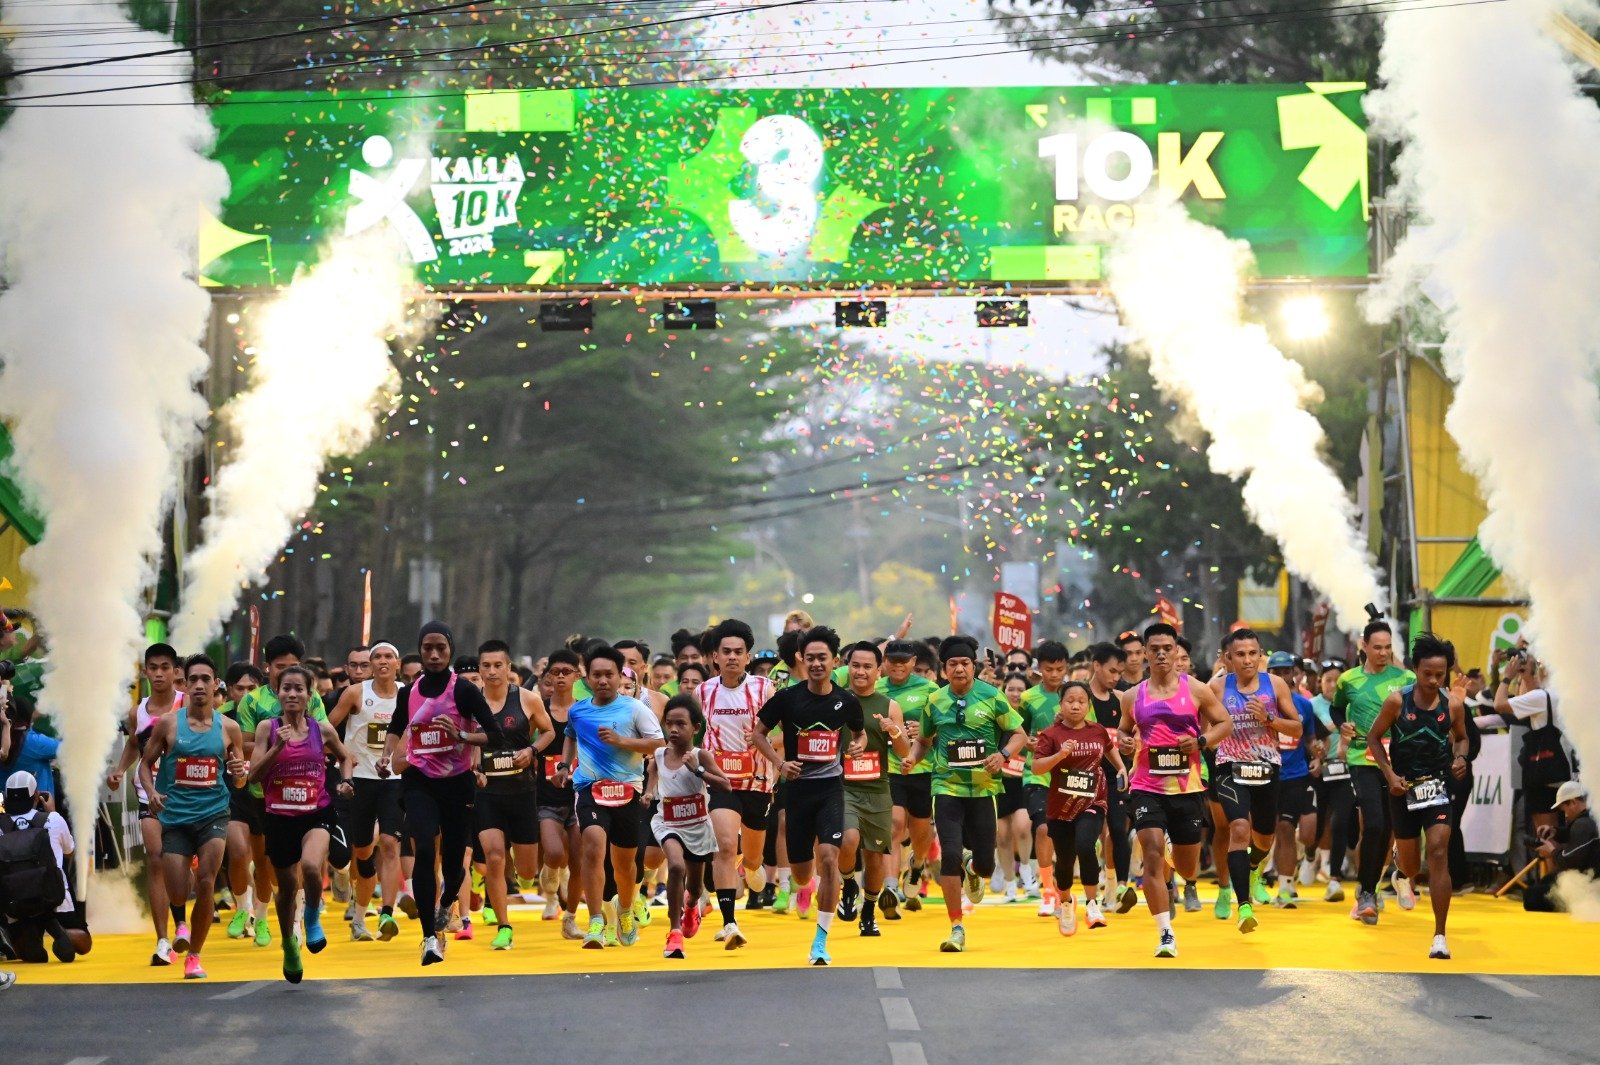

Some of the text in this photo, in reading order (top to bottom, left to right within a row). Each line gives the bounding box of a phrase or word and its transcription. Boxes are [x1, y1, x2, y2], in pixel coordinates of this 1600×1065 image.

[430, 153, 526, 182] KALLA
[1038, 131, 1227, 201] 10K
[728, 114, 825, 254] 3
[808, 739, 830, 752] 10221
[1066, 775, 1089, 790] 10545
[282, 786, 307, 802] 10555
[1414, 784, 1437, 801] 10722
[672, 802, 698, 818] 10530
